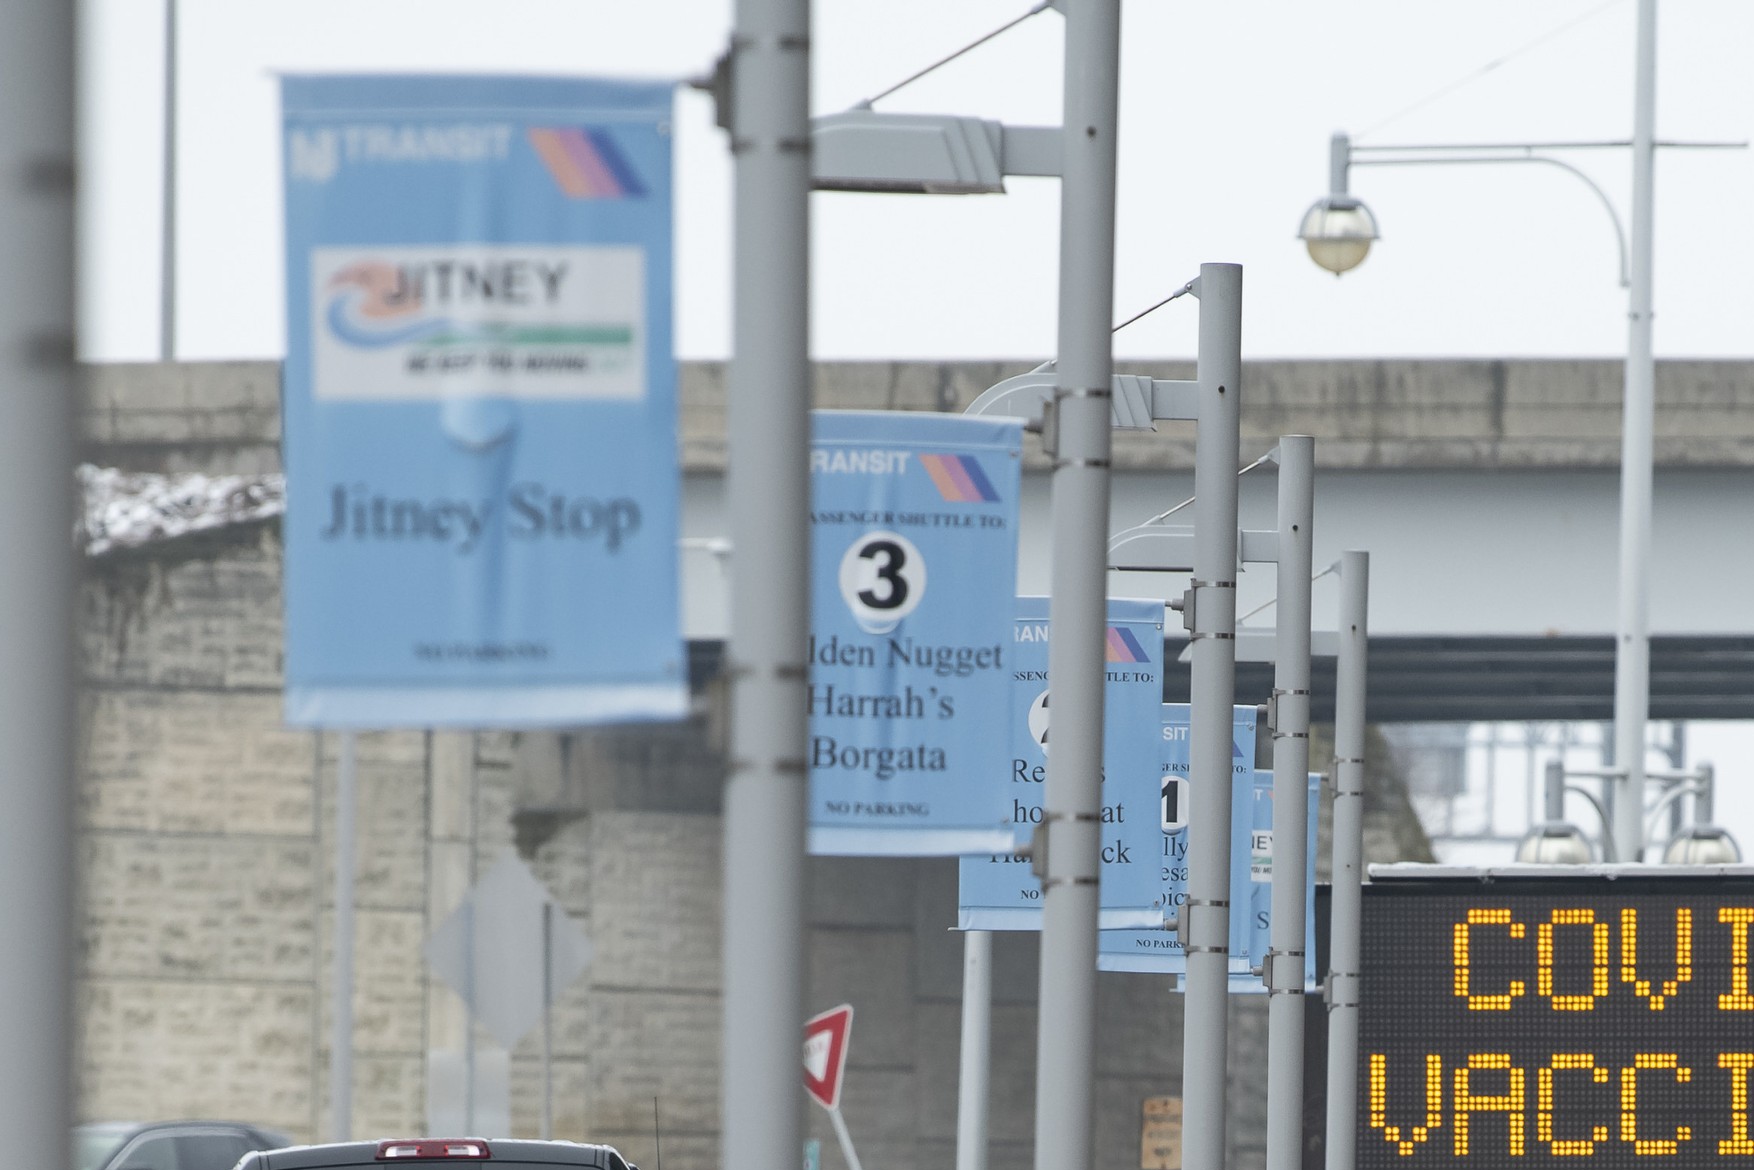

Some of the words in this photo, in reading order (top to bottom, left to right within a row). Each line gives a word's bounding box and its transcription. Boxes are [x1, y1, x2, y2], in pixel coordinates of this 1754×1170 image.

[343, 124, 514, 164] TRANSIT
[388, 260, 569, 306] JITNEY
[809, 450, 911, 477] RANSIT
[319, 482, 487, 554] Jitney
[507, 481, 642, 553] Stop
[808, 510, 896, 526] ASSENGER
[856, 540, 910, 610] 3
[808, 634, 876, 668] lden
[887, 636, 1004, 678] Nugget
[805, 682, 956, 720] Harrah's
[811, 731, 947, 781] Borgata
[825, 801, 849, 815] NO
[852, 802, 931, 818] PARKING
[1020, 889, 1040, 900] NO
[1136, 939, 1151, 948] NO
